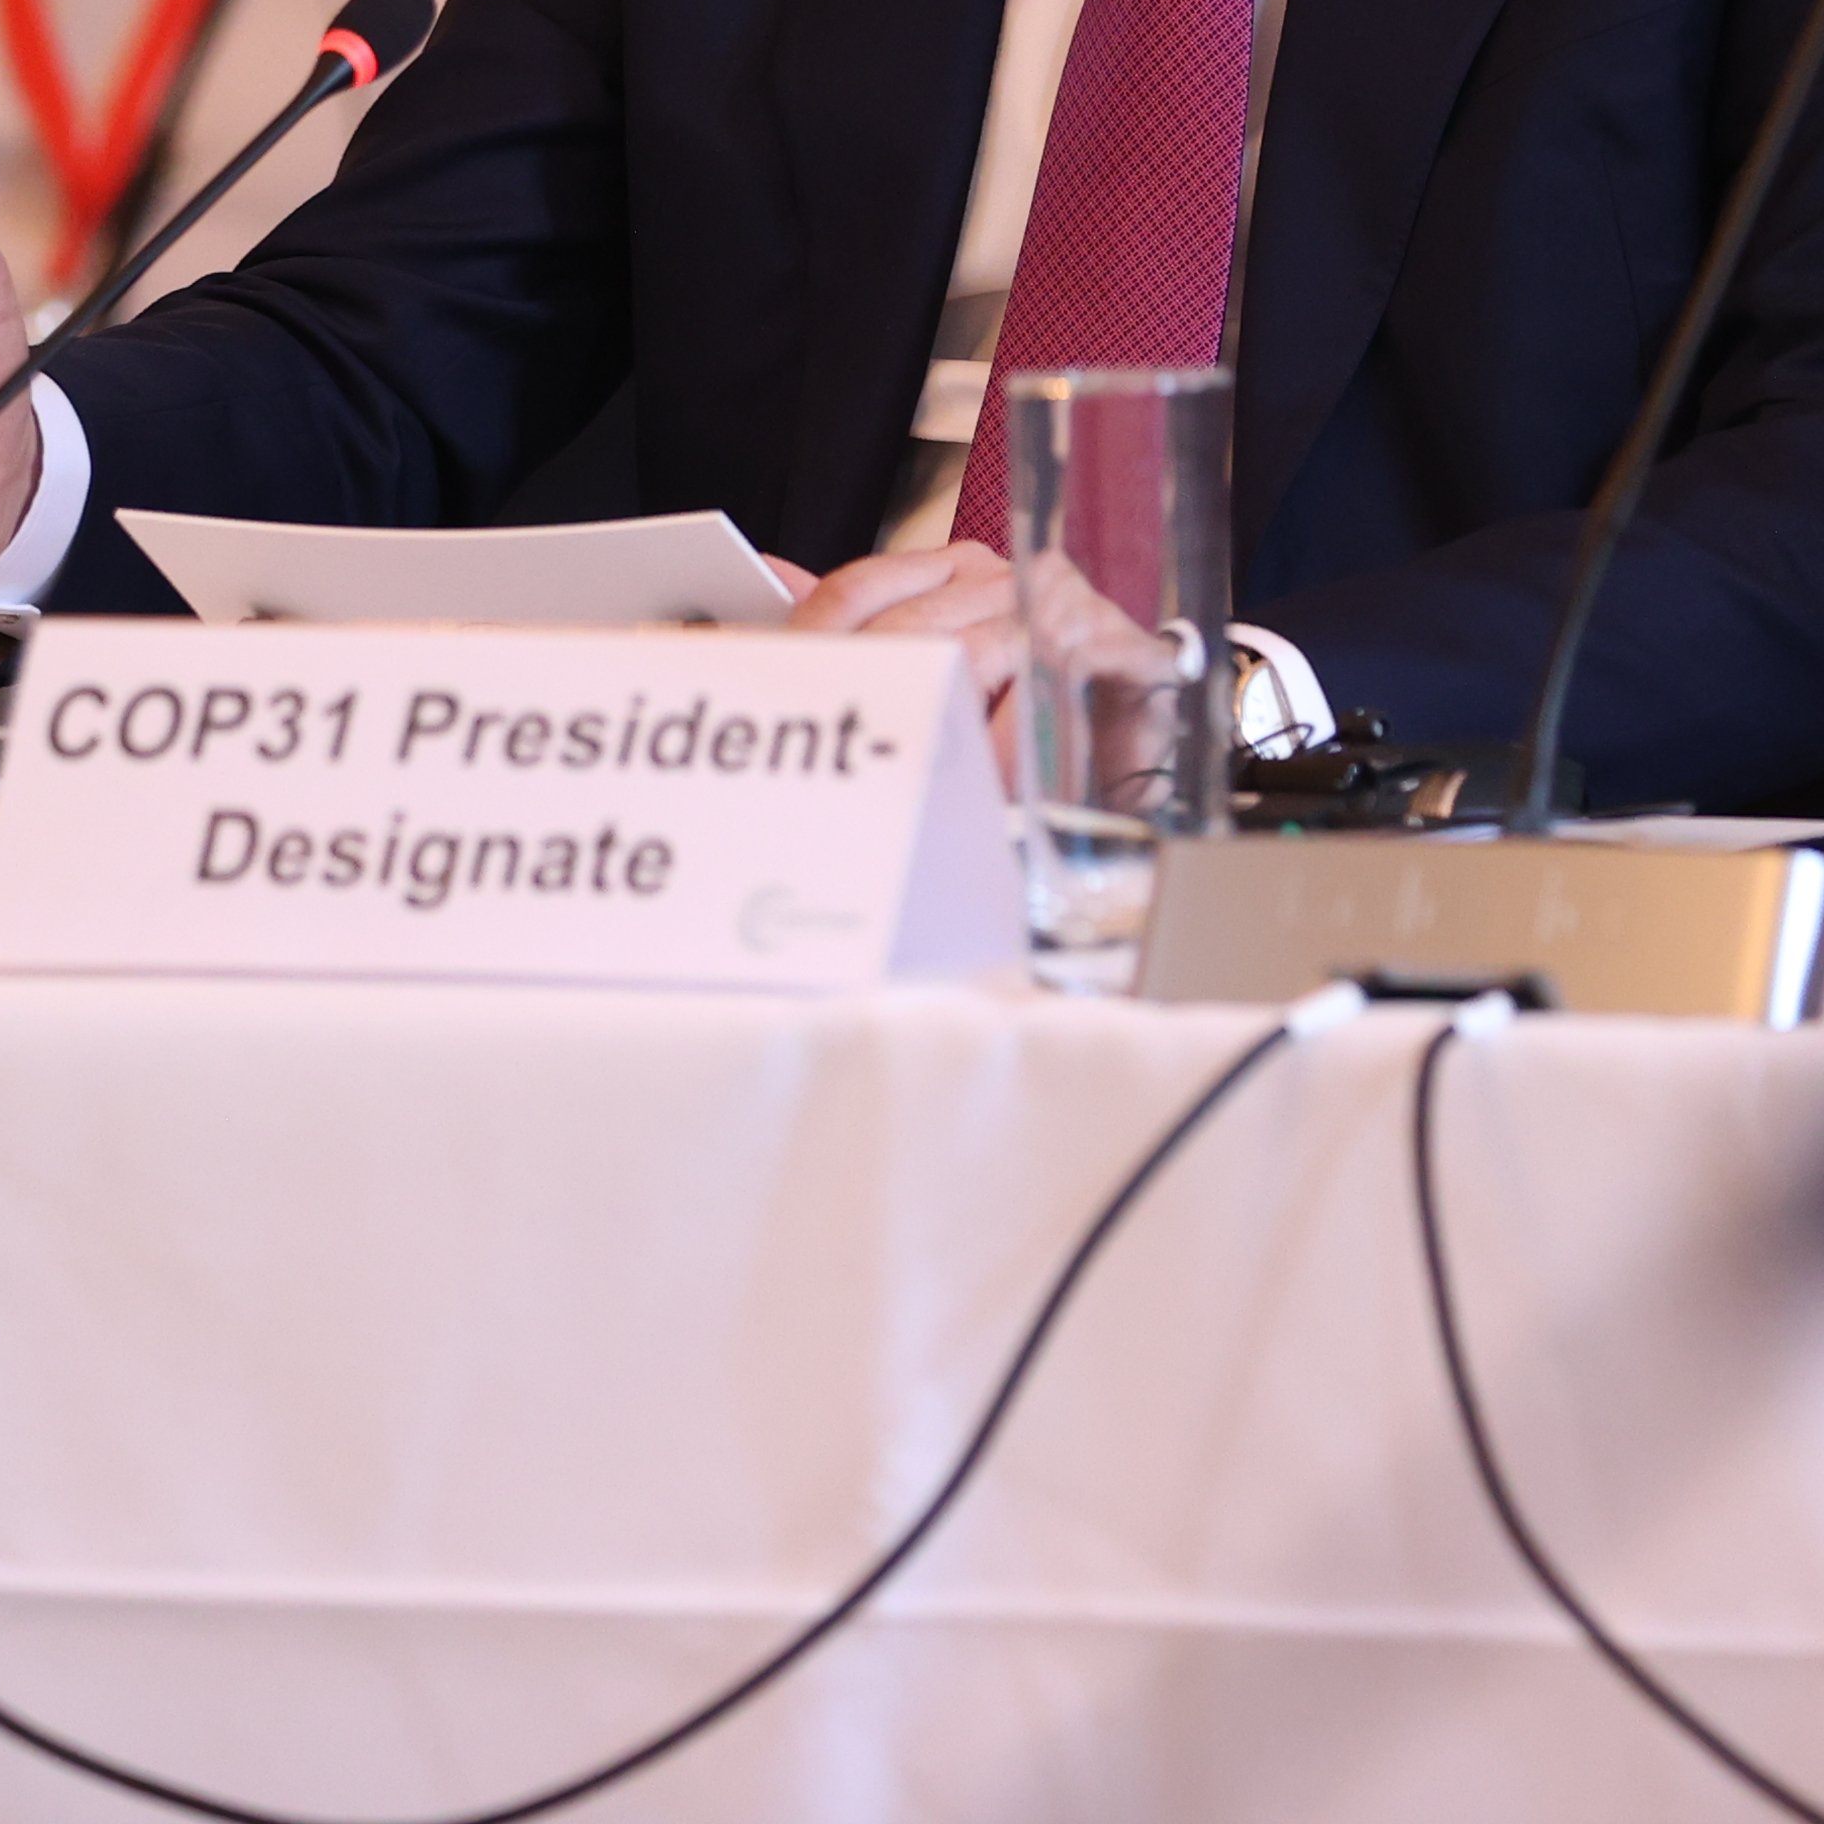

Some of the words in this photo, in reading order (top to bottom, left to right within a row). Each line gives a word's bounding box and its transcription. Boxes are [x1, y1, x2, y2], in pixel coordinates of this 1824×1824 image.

[45, 683, 360, 763] COP31
[396, 689, 899, 777] President-
[194, 808, 674, 911] Designate
